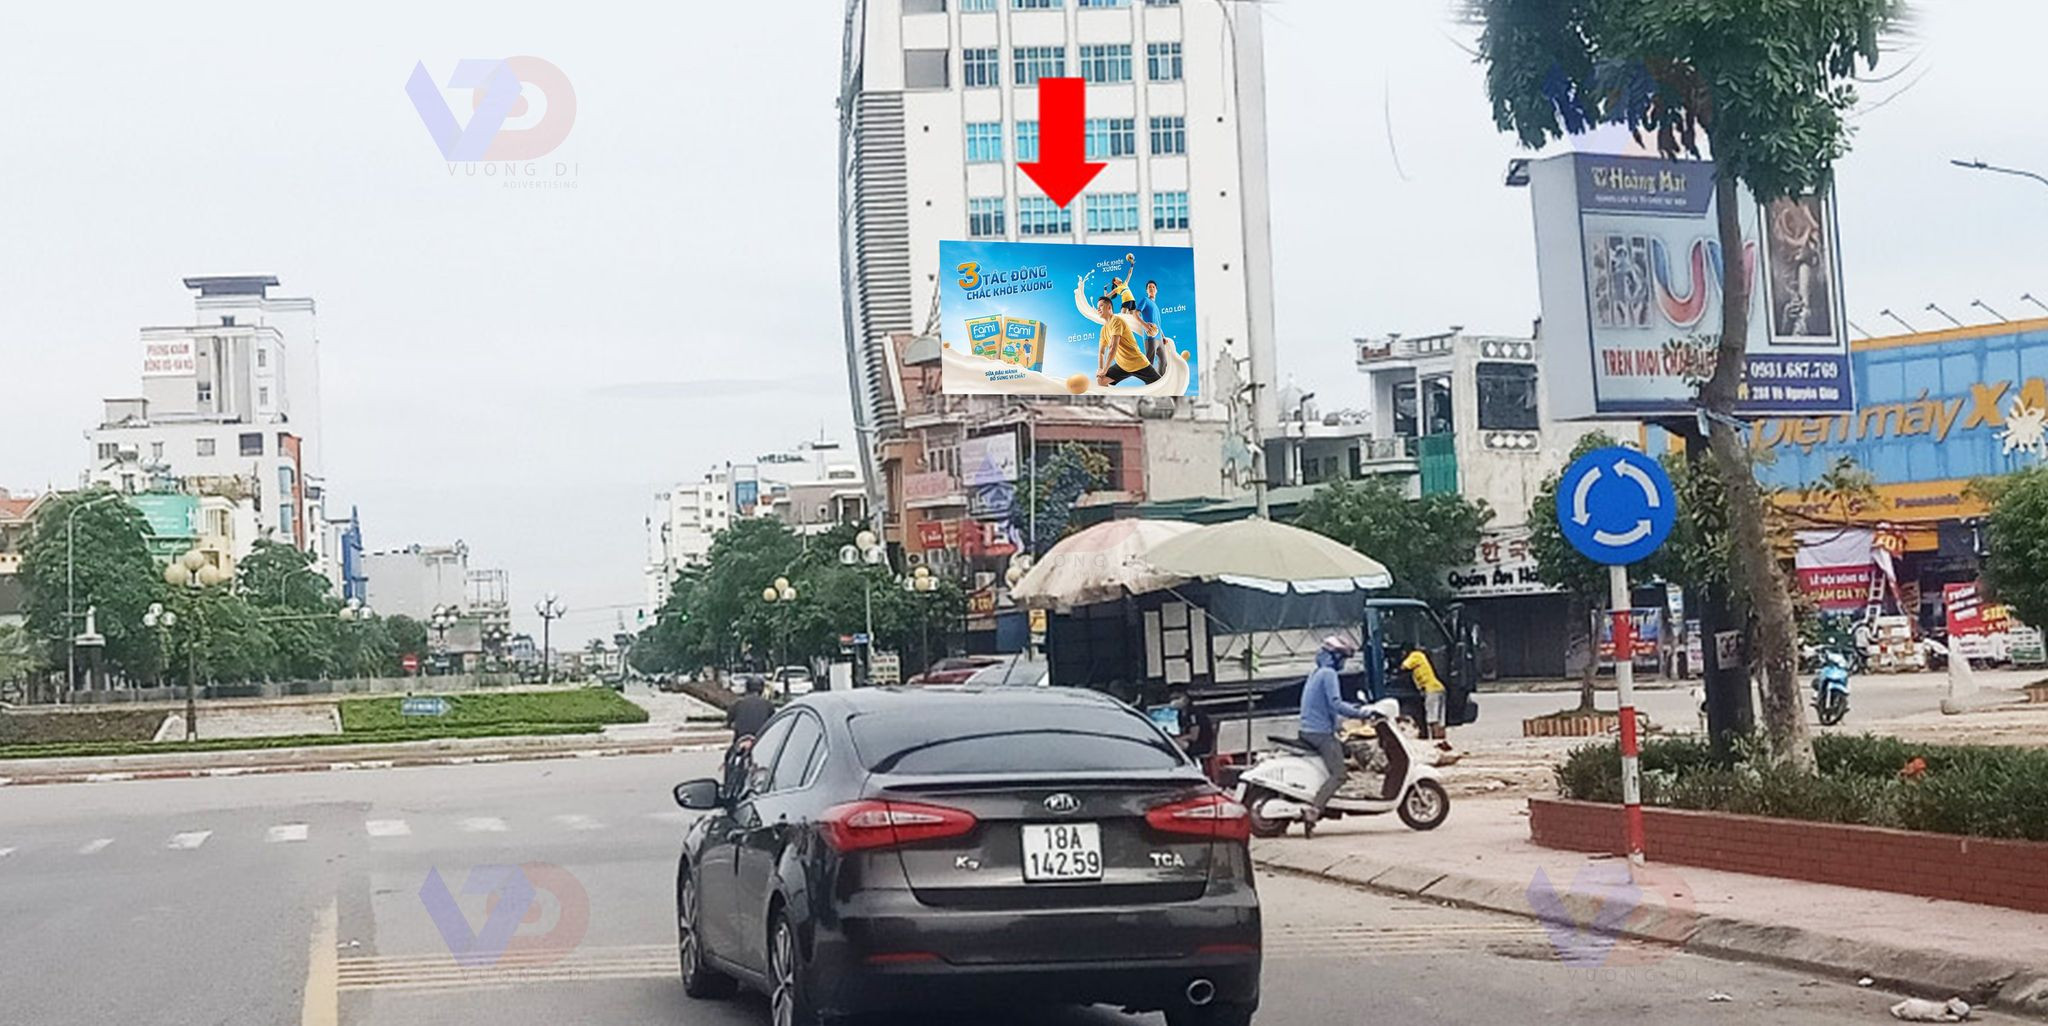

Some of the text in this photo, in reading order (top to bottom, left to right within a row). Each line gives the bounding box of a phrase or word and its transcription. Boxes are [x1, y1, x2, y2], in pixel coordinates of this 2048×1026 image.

[957, 261, 1047, 291] 3 TÁC ĐỘNG
[967, 286, 991, 301] CHẮC
[1856, 387, 1966, 443] máy
[1448, 568, 1487, 590] Quán
[1044, 826, 1082, 850] 18A
[1031, 851, 1100, 876] 142.59
[1149, 853, 1185, 867] TCA
